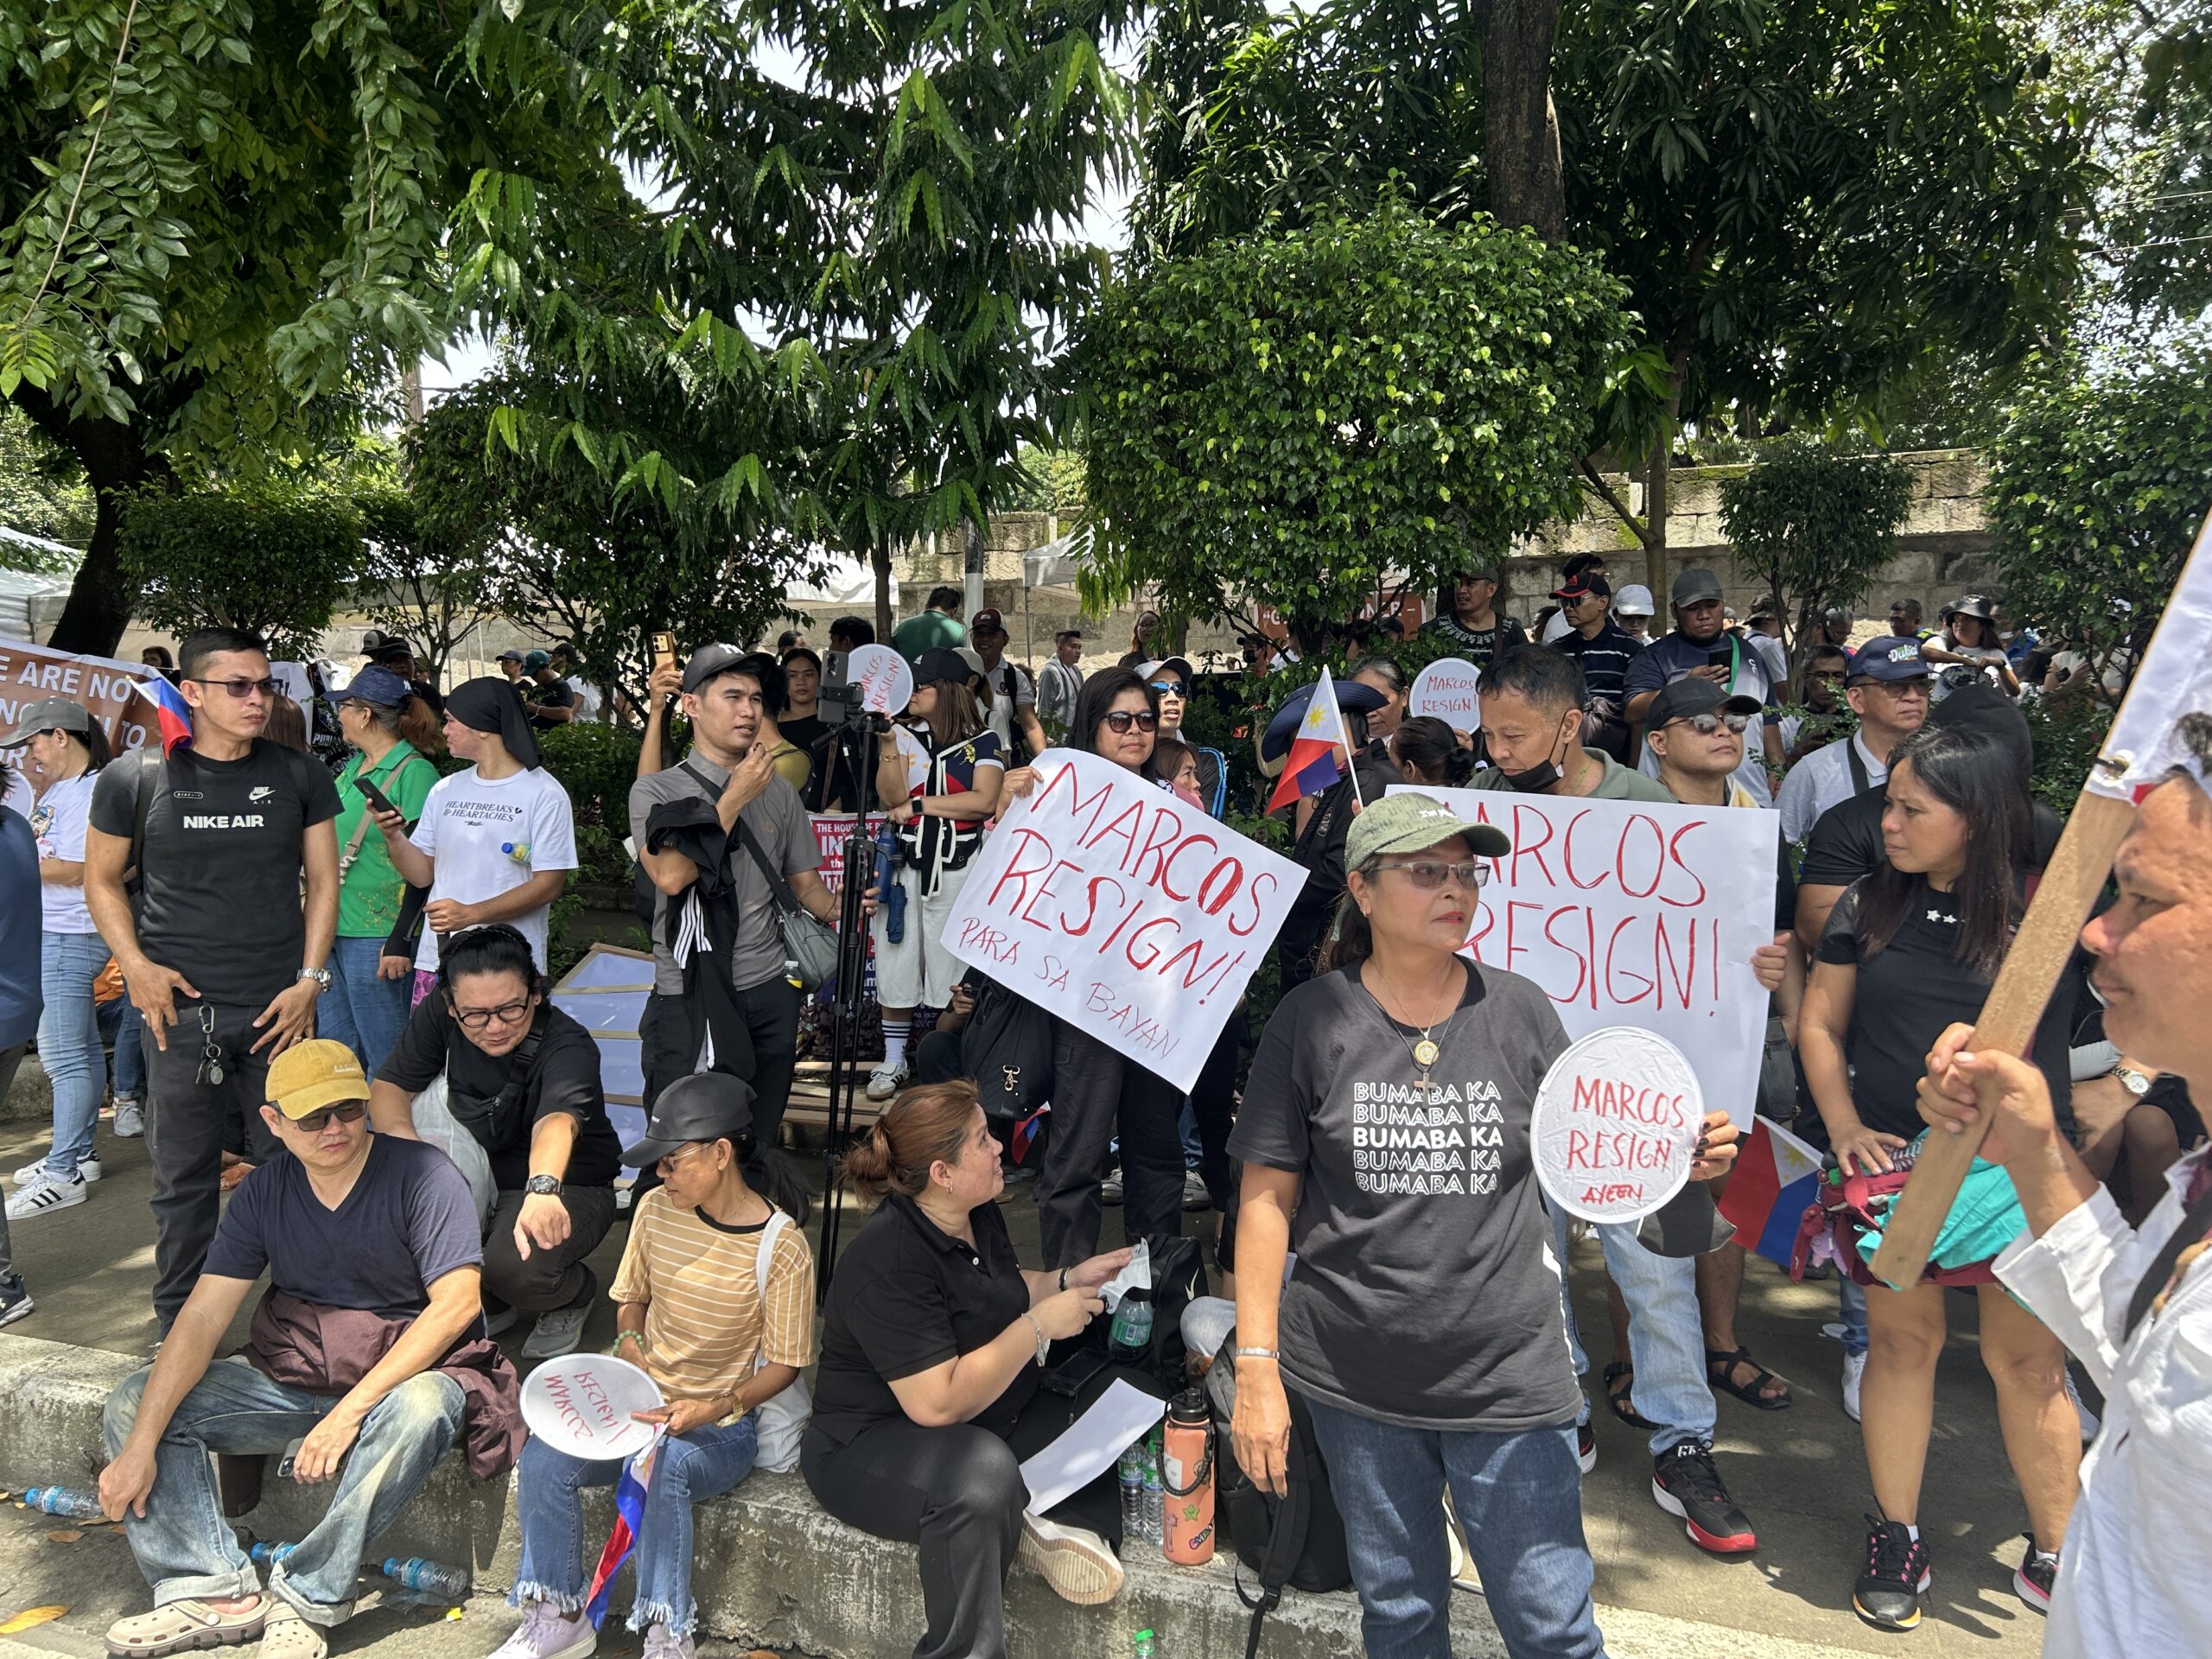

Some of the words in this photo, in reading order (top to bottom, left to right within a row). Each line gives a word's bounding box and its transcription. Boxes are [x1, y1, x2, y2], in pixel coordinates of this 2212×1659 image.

[17, 661, 81, 695] ARE
[1426, 676, 1475, 693] MARCOS
[445, 800, 514, 814] HEARTBREAKS
[452, 809, 515, 823] HEARTACHES
[183, 816, 229, 829] NIKE
[231, 815, 264, 828] AIR
[817, 823, 831, 833] THE
[1029, 761, 1278, 937] MARCOS
[1445, 801, 1707, 907] ARCOS
[987, 828, 1247, 1005] RESIGN!
[959, 917, 1021, 965] PARA
[1034, 955, 1070, 992] SA
[1085, 982, 1180, 1060] BAYAN
[1354, 1082, 1462, 1105] BUMABA
[1466, 1081, 1502, 1101] KA
[1573, 1075, 1684, 1128] MARCOS
[1353, 1103, 1465, 1127] BUMABA
[1469, 1103, 1504, 1123] KA
[1353, 1127, 1465, 1149] BUMABA
[1471, 1127, 1503, 1147] KA
[1353, 1150, 1465, 1172] BUMABA
[1471, 1150, 1502, 1170] KA
[1567, 1129, 1671, 1173] RESIGN
[1355, 1172, 1465, 1195] BUMABA
[1471, 1173, 1497, 1194] KA
